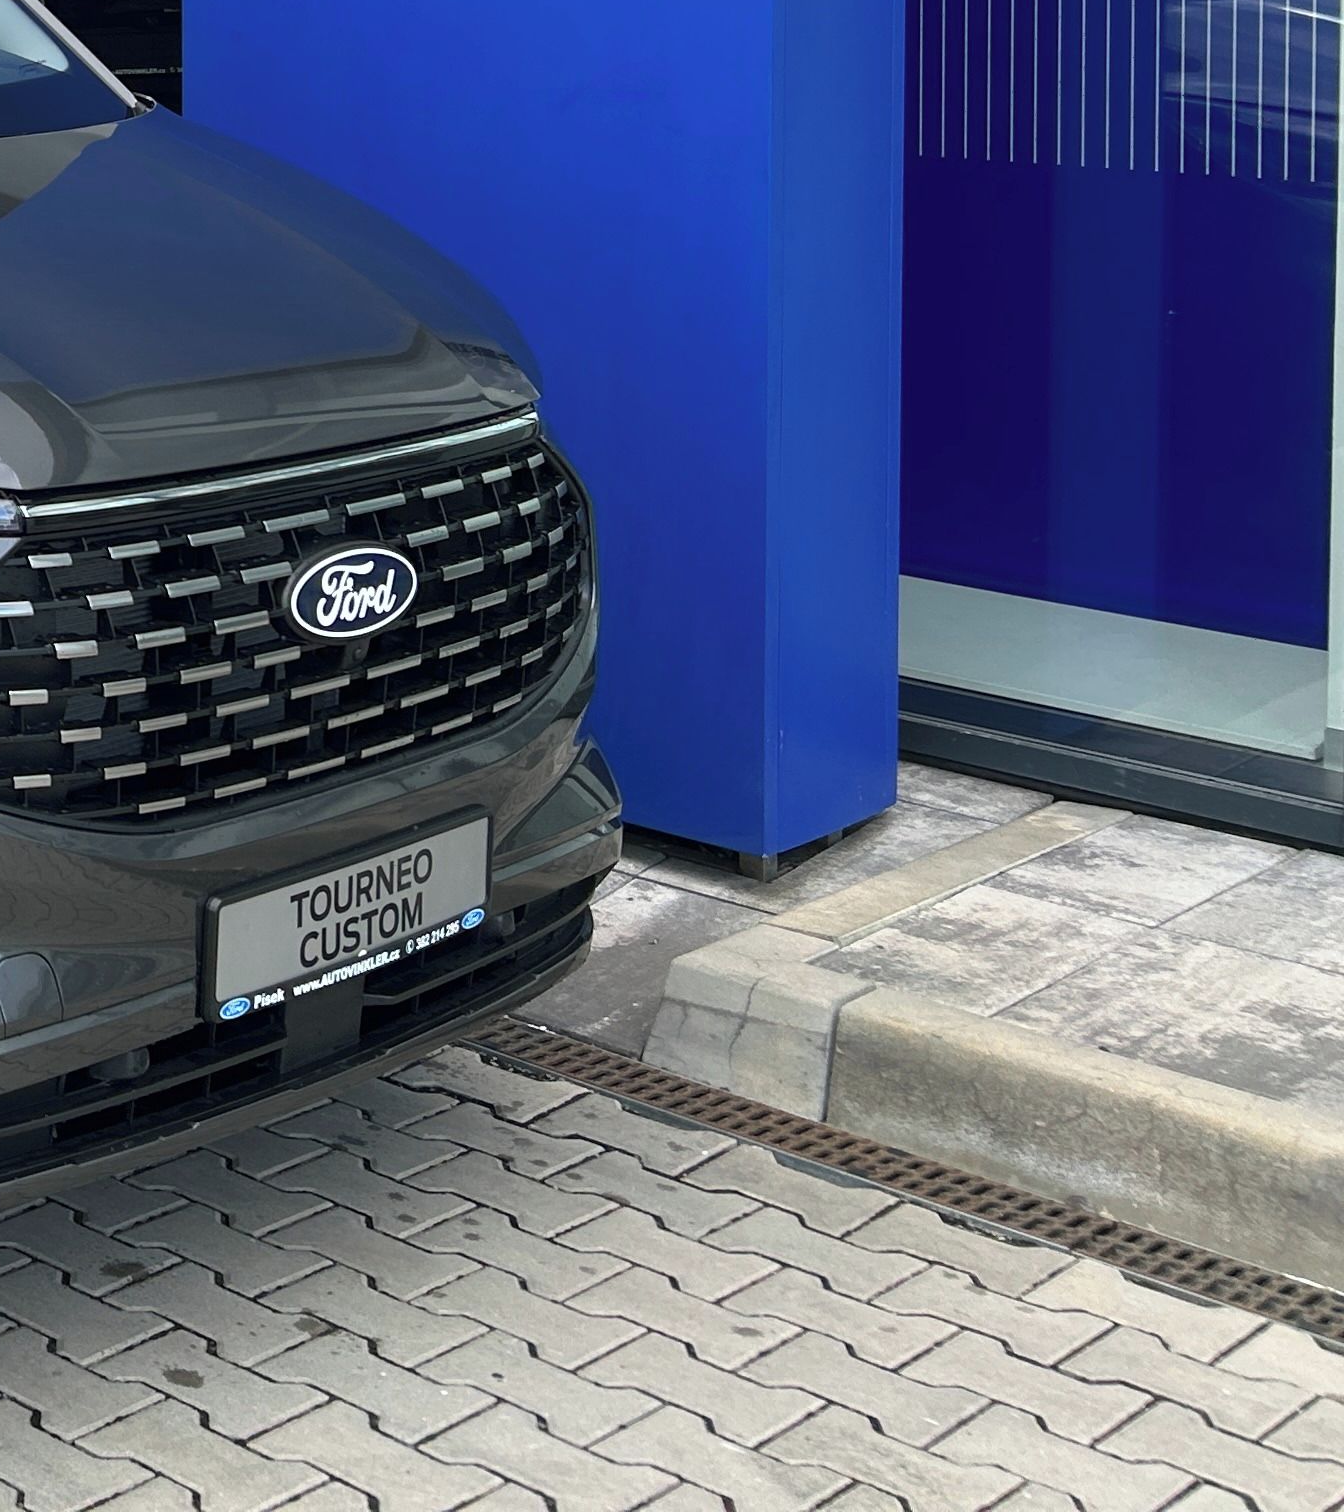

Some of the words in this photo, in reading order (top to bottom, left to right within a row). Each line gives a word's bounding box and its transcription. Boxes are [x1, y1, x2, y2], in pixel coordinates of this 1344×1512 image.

[317, 560, 397, 627] Ford
[290, 848, 433, 928] TOURNEO
[300, 892, 423, 968] CUSTOM
[293, 949, 401, 996] www.AUTOVINKLER.cz
